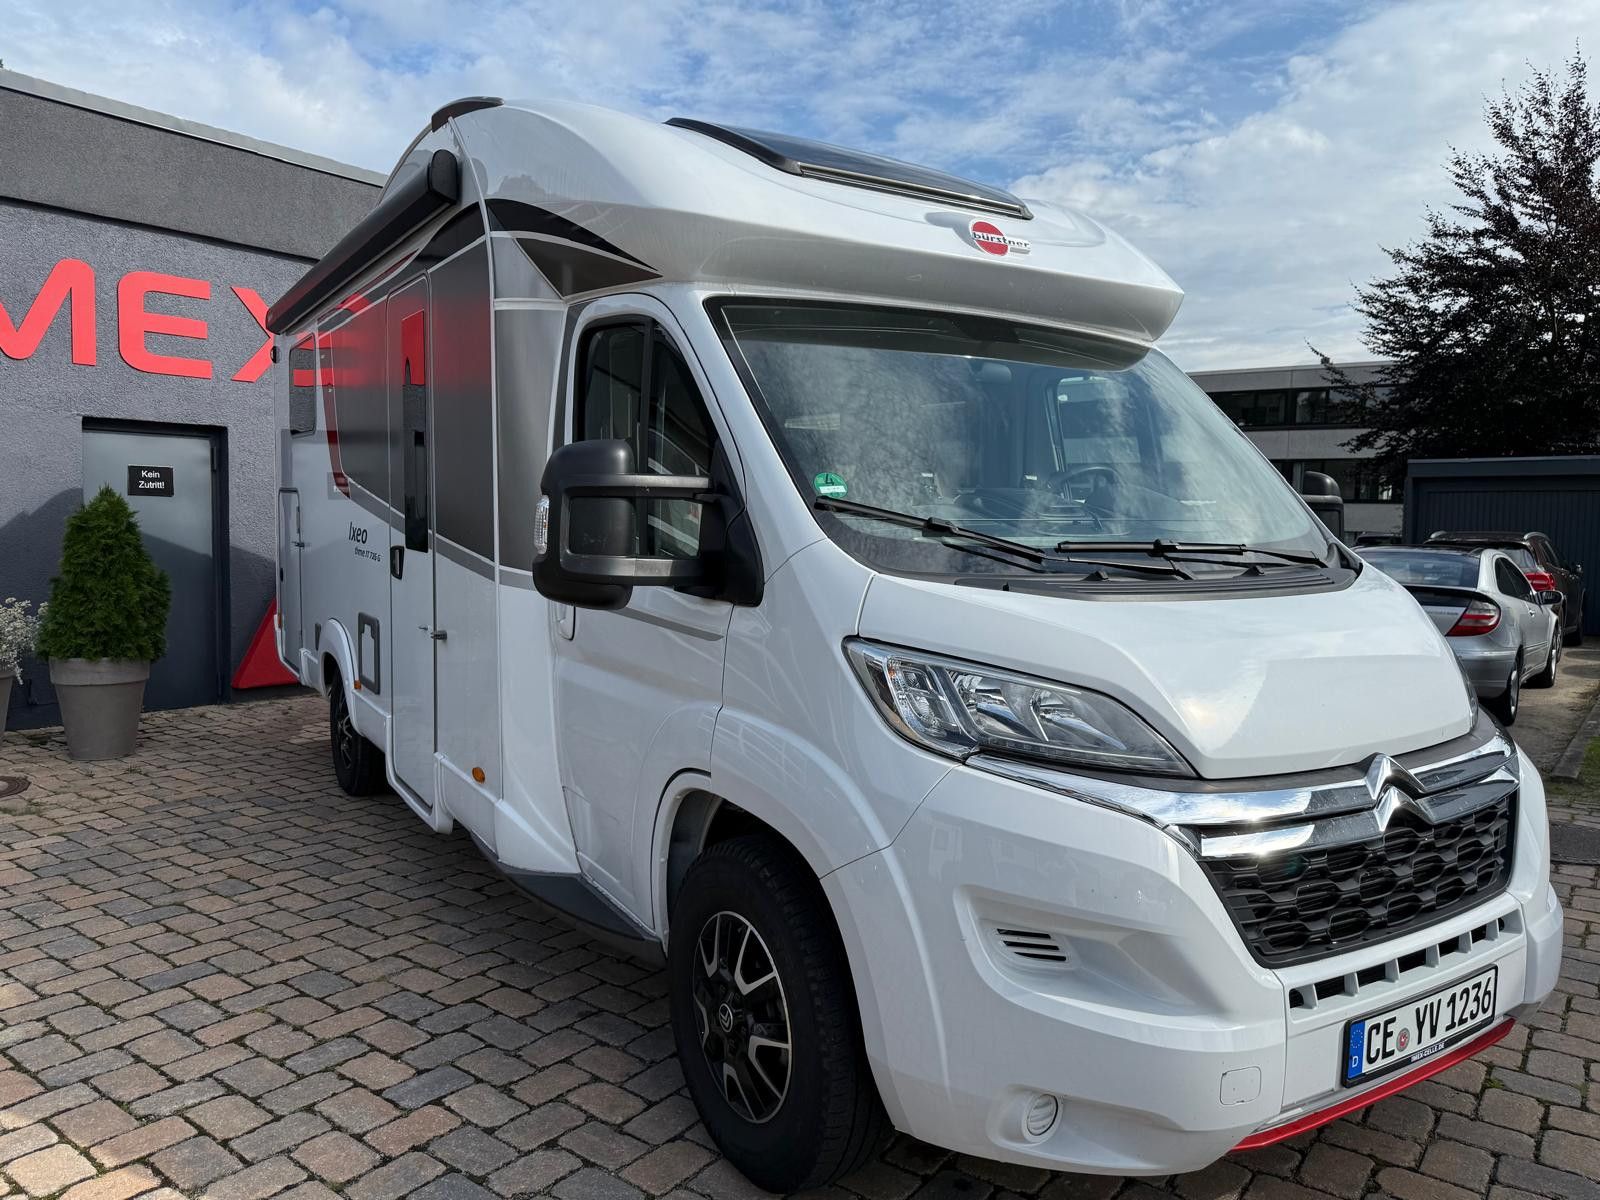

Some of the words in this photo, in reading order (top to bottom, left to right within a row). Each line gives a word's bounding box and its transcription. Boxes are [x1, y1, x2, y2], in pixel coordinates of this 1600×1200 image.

[972, 232, 1030, 247] bürstner
[141, 470, 160, 478] Kein
[825, 473, 835, 486] 4
[138, 480, 165, 489] Zutritt!
[348, 521, 368, 544] Ixeo
[1366, 1016, 1397, 1065] CE
[1415, 998, 1442, 1046] YV
[1445, 976, 1492, 1032] 1236
[1351, 1055, 1359, 1068] D
